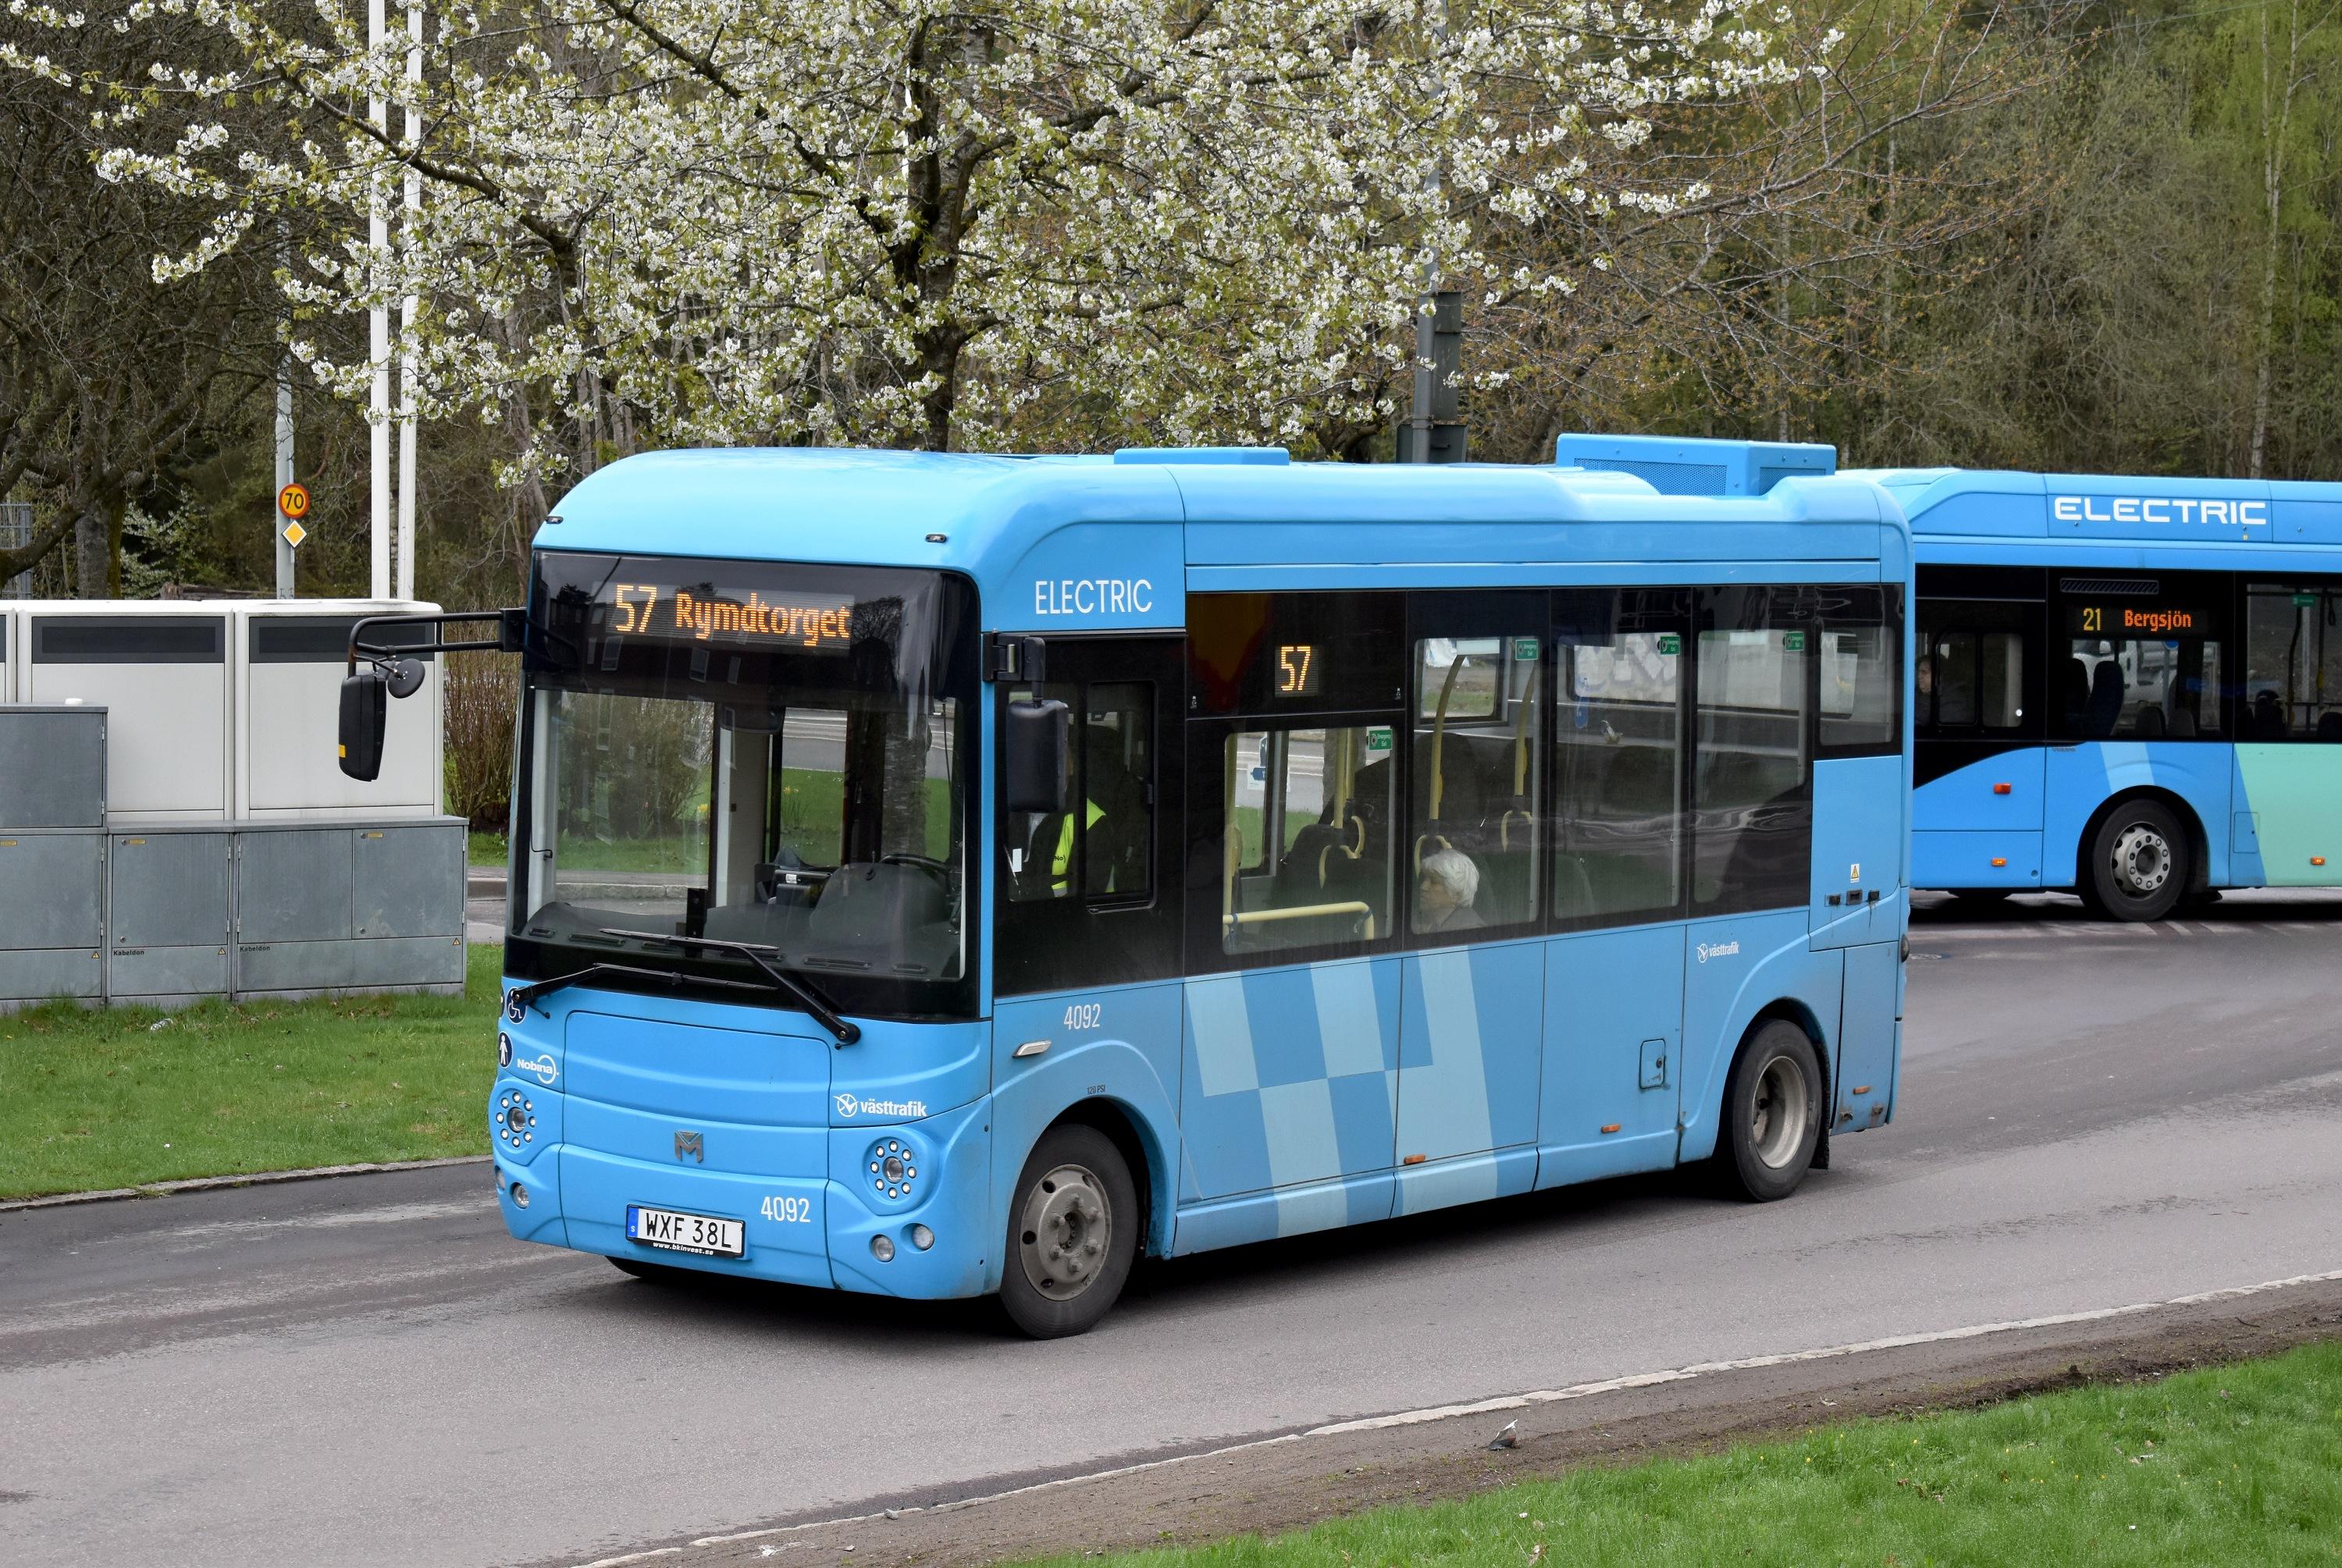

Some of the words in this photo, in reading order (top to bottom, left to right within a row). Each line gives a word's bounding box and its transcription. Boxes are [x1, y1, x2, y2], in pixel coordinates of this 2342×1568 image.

[285, 492, 304, 510] 70
[2055, 497, 2266, 525] ELECTRIC
[1035, 579, 1153, 614] ELECTRIC
[616, 585, 657, 632] 57
[676, 593, 849, 646] Rymdtorget
[2083, 608, 2102, 631] 21
[2124, 610, 2191, 631] Bergsjön
[1281, 646, 1311, 691] 57
[1709, 941, 1739, 957] västtrafik
[1063, 1003, 1102, 1030] 4092
[860, 1099, 927, 1117] västtrafik
[760, 1196, 811, 1223] 4092
[646, 1212, 685, 1240] WXF
[692, 1220, 731, 1248] 38L
[653, 1242, 714, 1256] www.bkinvest.se
